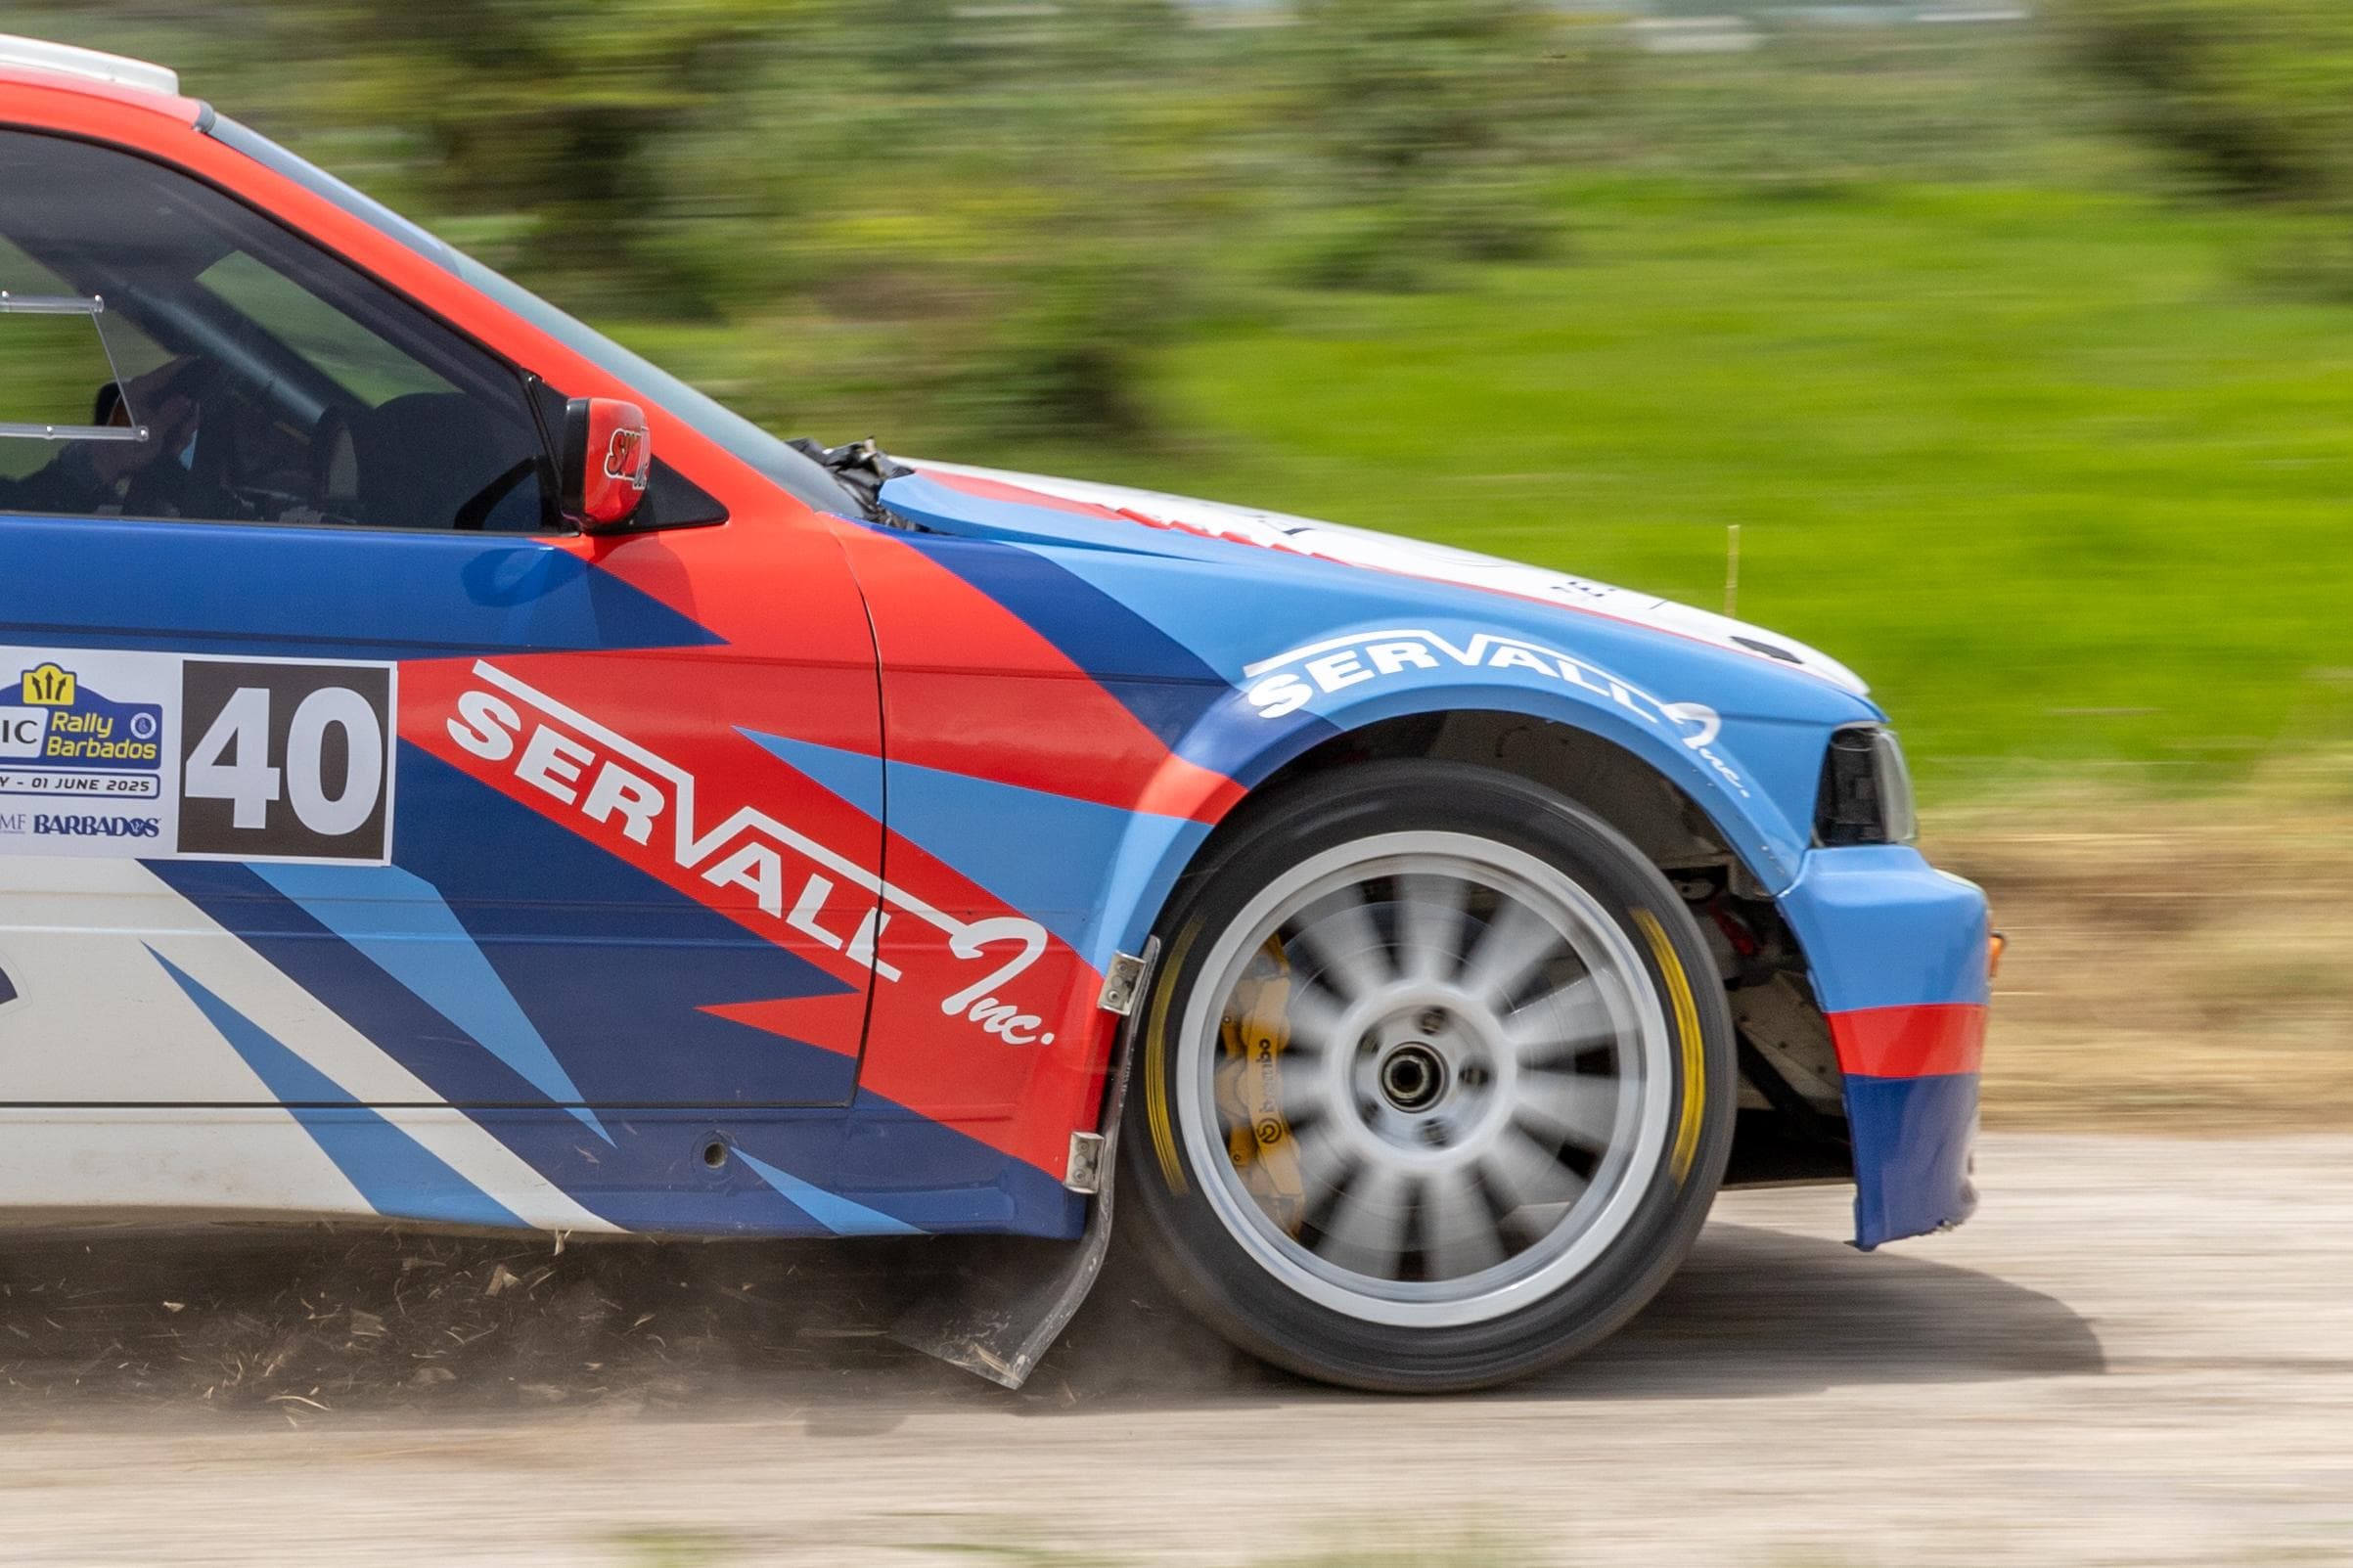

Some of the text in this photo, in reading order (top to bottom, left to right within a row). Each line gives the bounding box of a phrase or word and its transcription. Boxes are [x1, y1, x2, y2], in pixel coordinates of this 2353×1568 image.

[1244, 629, 1659, 723] SERVALL
[51, 711, 113, 739] Rally
[46, 737, 157, 760] Barbados
[184, 686, 384, 835] 40
[31, 778, 48, 788] 01
[55, 778, 100, 790] JUNE
[106, 780, 150, 791] 2025
[33, 814, 160, 838] BARBADOS
[446, 658, 1055, 1045] SERVALL Inc.
